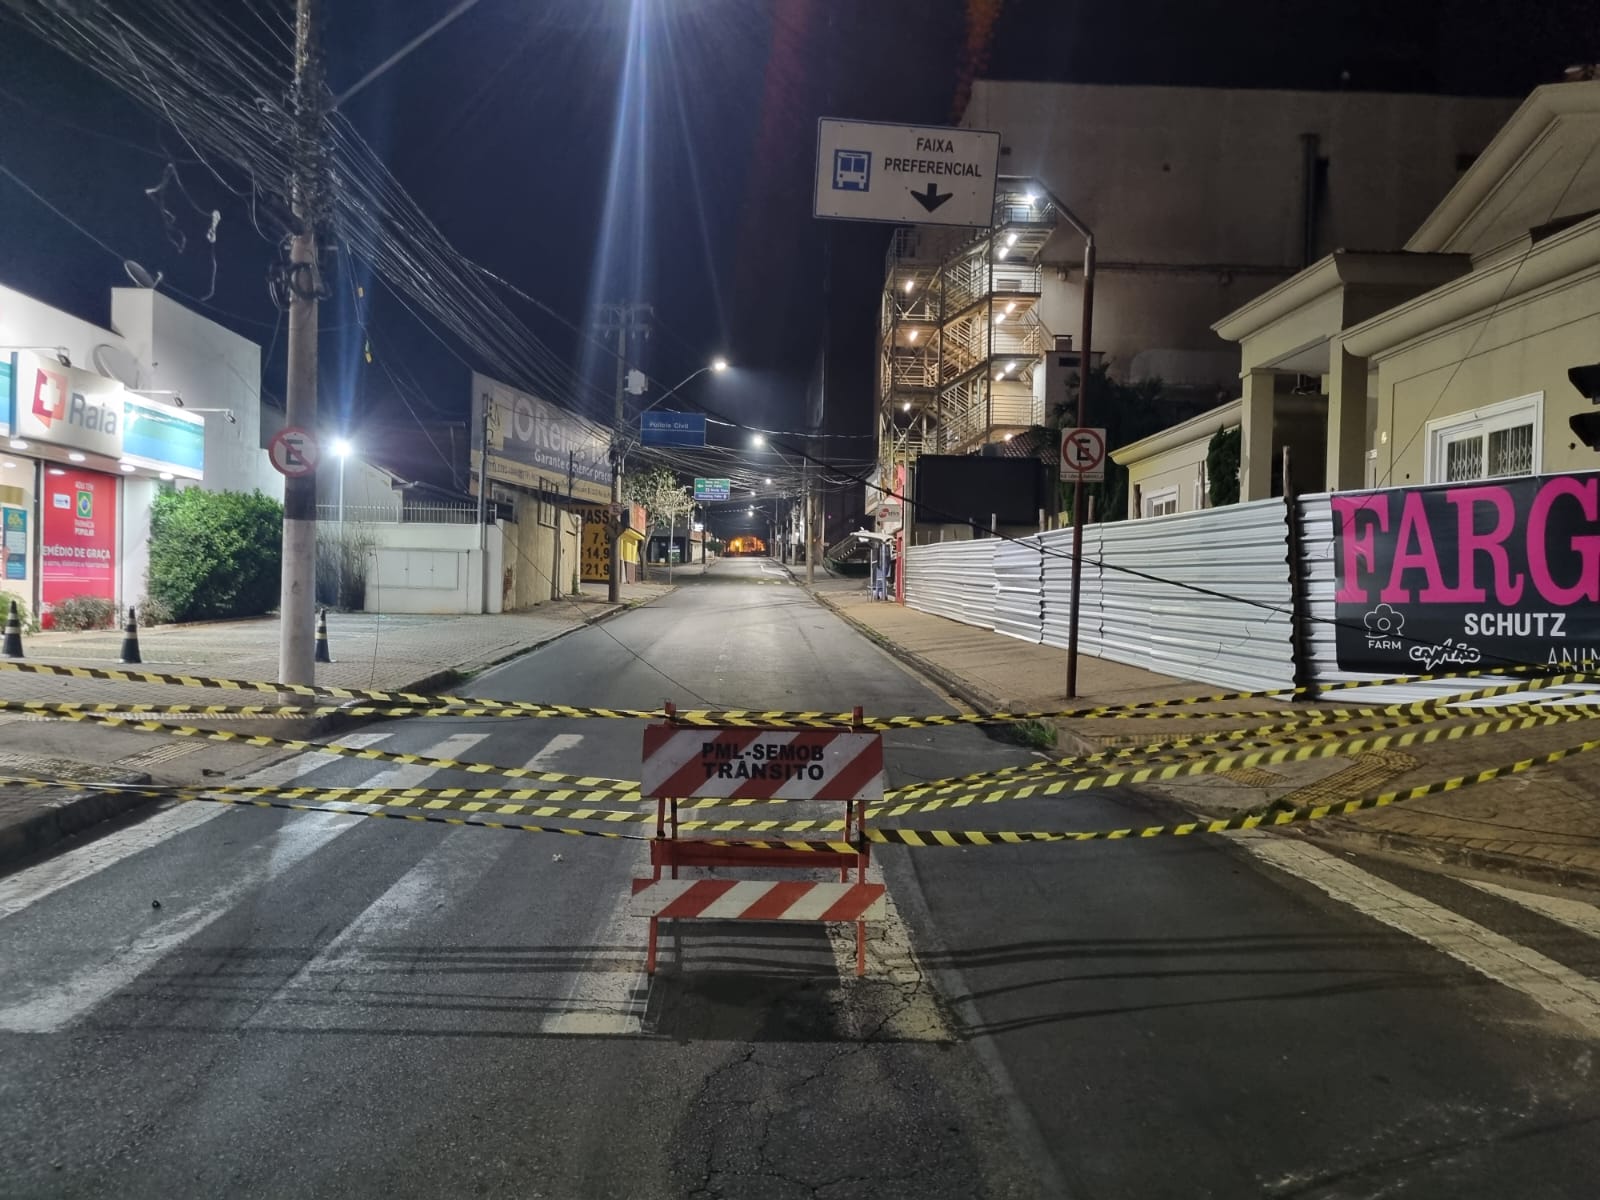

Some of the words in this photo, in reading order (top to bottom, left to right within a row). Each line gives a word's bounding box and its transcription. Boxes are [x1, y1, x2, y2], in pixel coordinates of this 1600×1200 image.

[916, 137, 954, 153] FAIXA
[883, 157, 982, 177] PREFERENCIAL
[68, 392, 117, 436] Raia
[286, 438, 304, 465] E
[534, 448, 564, 470] Garante
[1076, 438, 1091, 461] E
[1330, 476, 1600, 606] FARG
[74, 548, 86, 558] DE
[86, 549, 111, 560] GRAÇA
[1464, 612, 1566, 637] SCHUTZ
[1368, 639, 1402, 650] FARM
[701, 742, 824, 762] PML-SEMOB
[702, 762, 825, 780] TRÂNSITO
